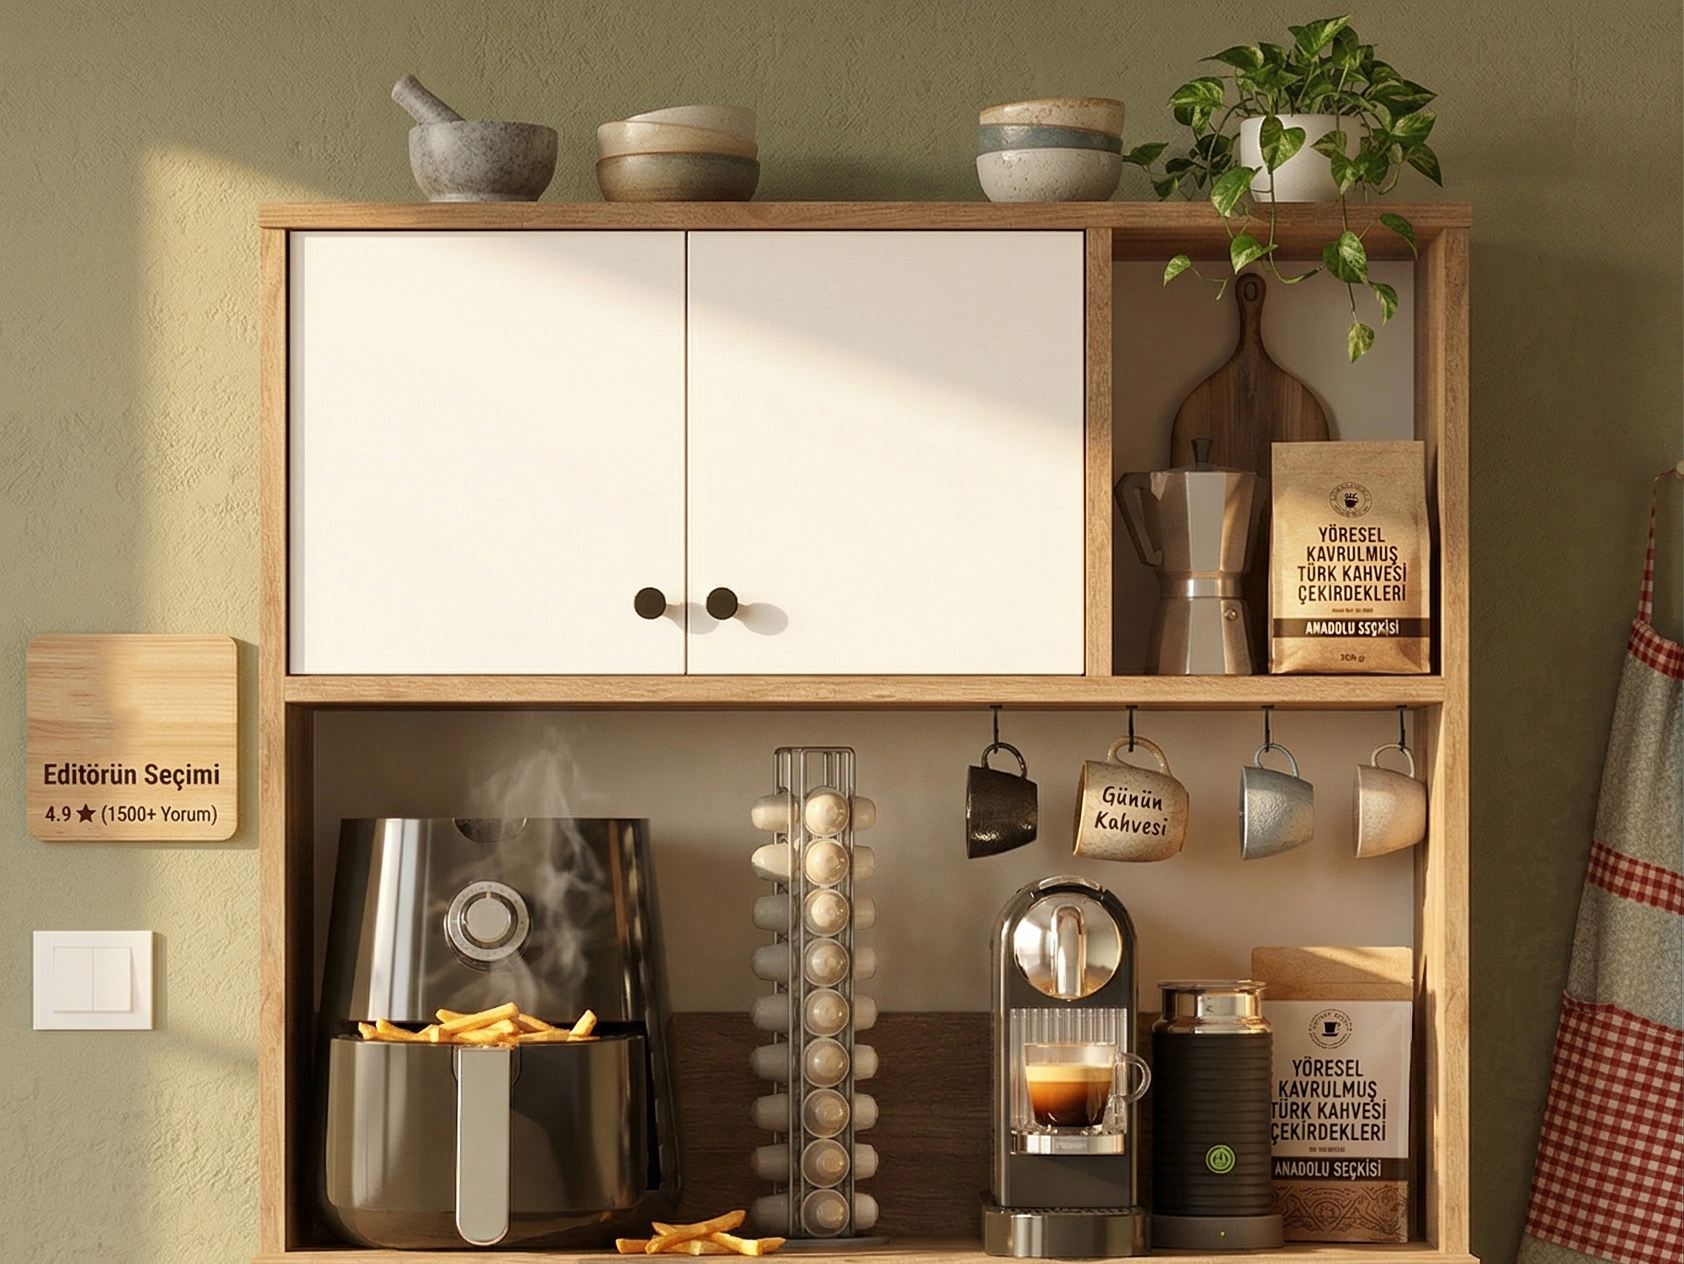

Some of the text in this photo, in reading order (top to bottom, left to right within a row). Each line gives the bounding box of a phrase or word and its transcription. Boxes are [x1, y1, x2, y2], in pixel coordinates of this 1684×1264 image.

[1318, 523, 1386, 543] YÖRESEL
[1306, 545, 1399, 566] KAVRULMUŞ
[1297, 562, 1407, 582] TÜRK KAHVESİ
[43, 762, 220, 792] Editörün Seçimi
[1102, 785, 1163, 812] Günün
[44, 804, 218, 826] 4.9 (1500+ Yorum)
[1094, 810, 1169, 837] Kahvesi
[1292, 1056, 1364, 1077] YÖRESEL
[1278, 1080, 1378, 1103] KAVRULMUŞ
[1271, 1098, 1386, 1120] TÜRK KAHVESİ
[1271, 1120, 1386, 1146] ÇEKİRDEKLERİ
[1274, 1158, 1382, 1181] ANADOLU SEÇKİSİ
